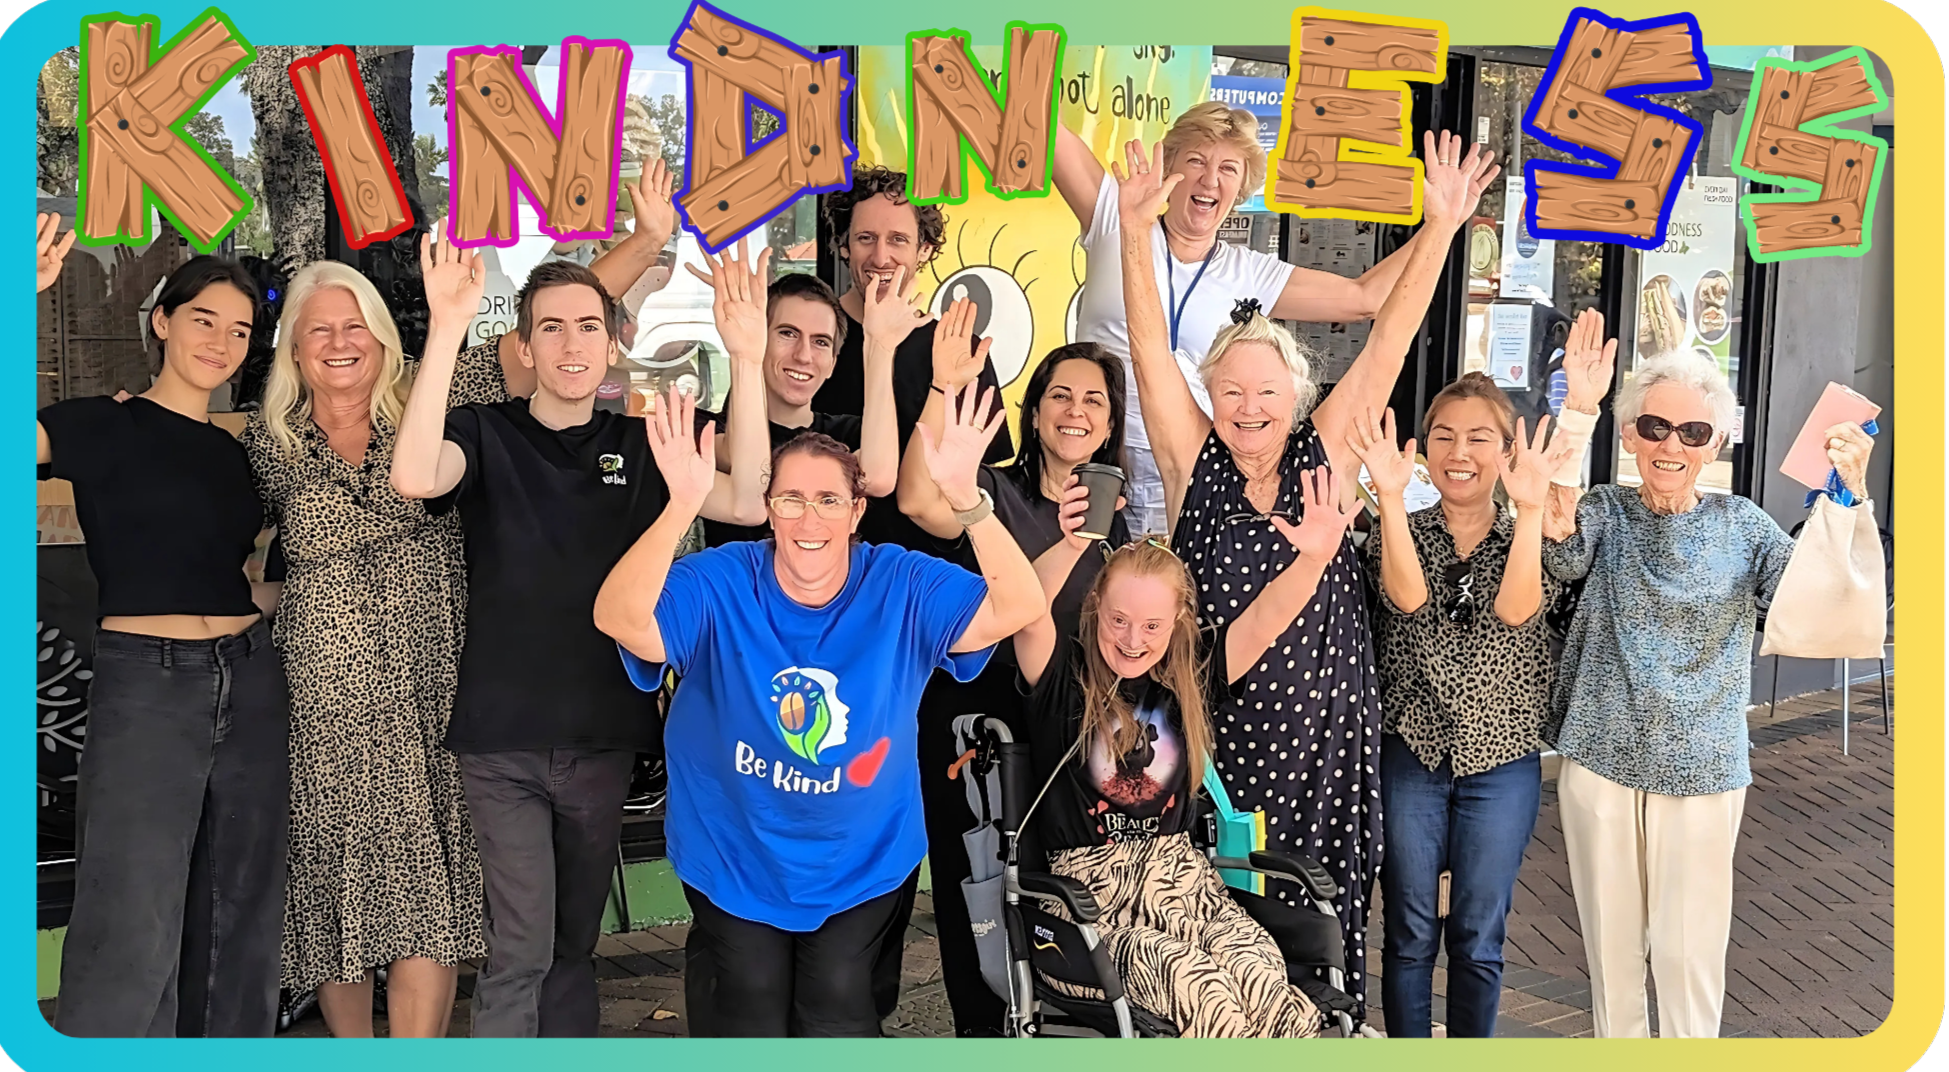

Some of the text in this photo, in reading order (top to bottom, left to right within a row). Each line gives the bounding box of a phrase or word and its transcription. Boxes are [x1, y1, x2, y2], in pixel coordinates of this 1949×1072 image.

[1111, 74, 1171, 125] alone
[735, 739, 842, 796] Be Kind
